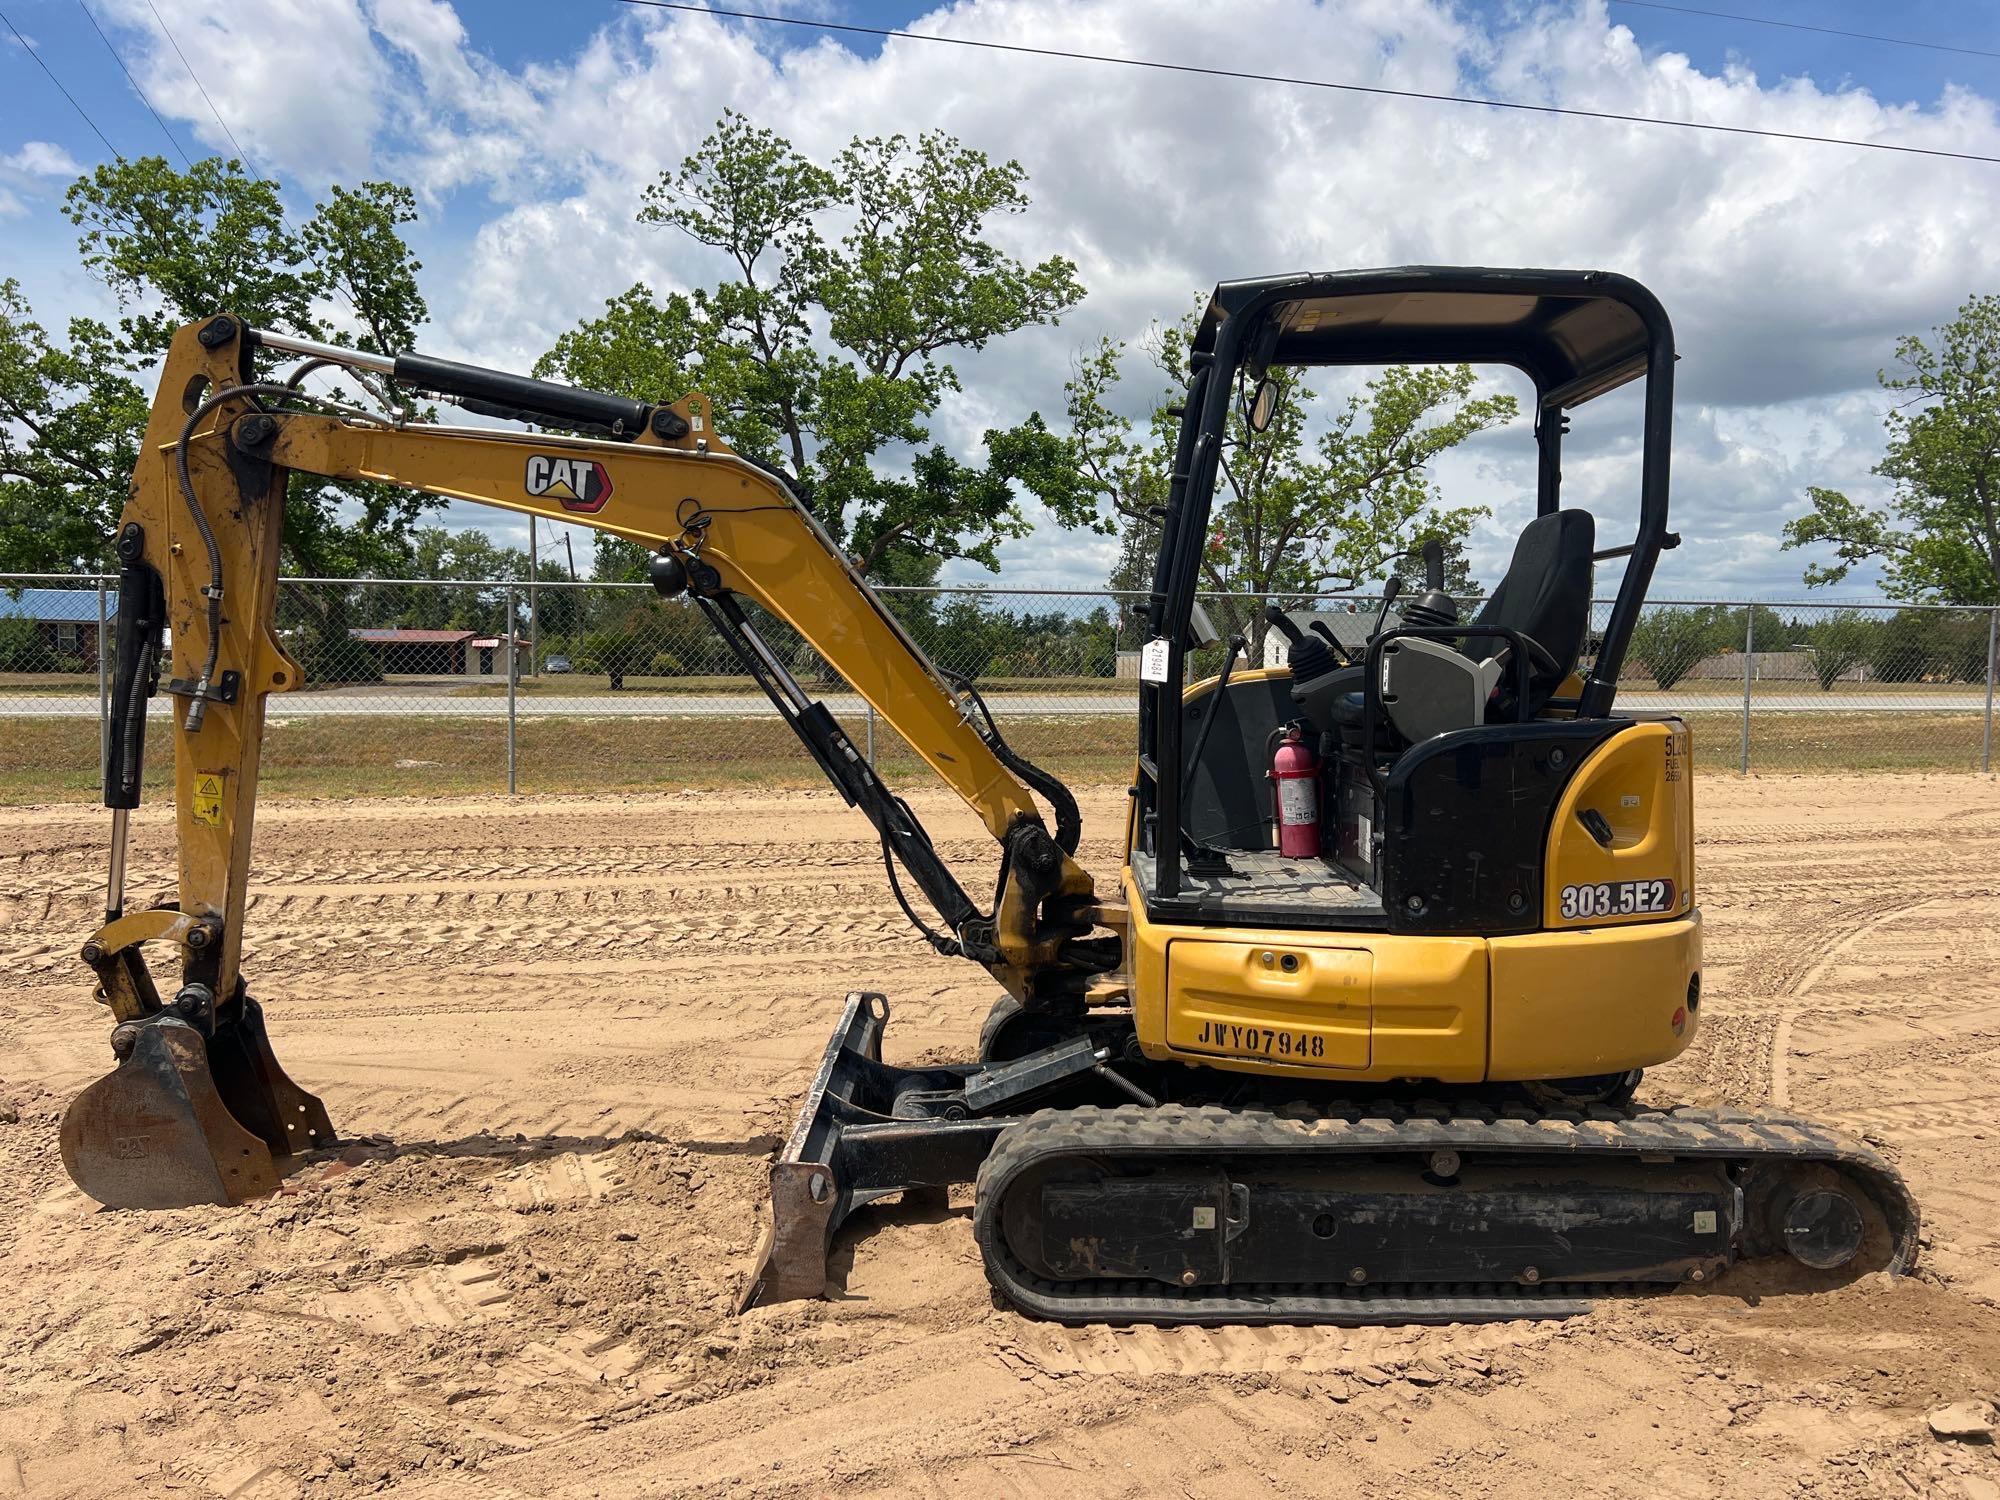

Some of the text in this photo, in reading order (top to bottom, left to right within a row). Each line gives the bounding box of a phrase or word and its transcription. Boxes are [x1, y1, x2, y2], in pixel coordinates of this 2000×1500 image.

[527, 455, 593, 500] CAT
[1561, 880, 1666, 919] 303.5E2
[1198, 1021, 1325, 1058] JWY07948
